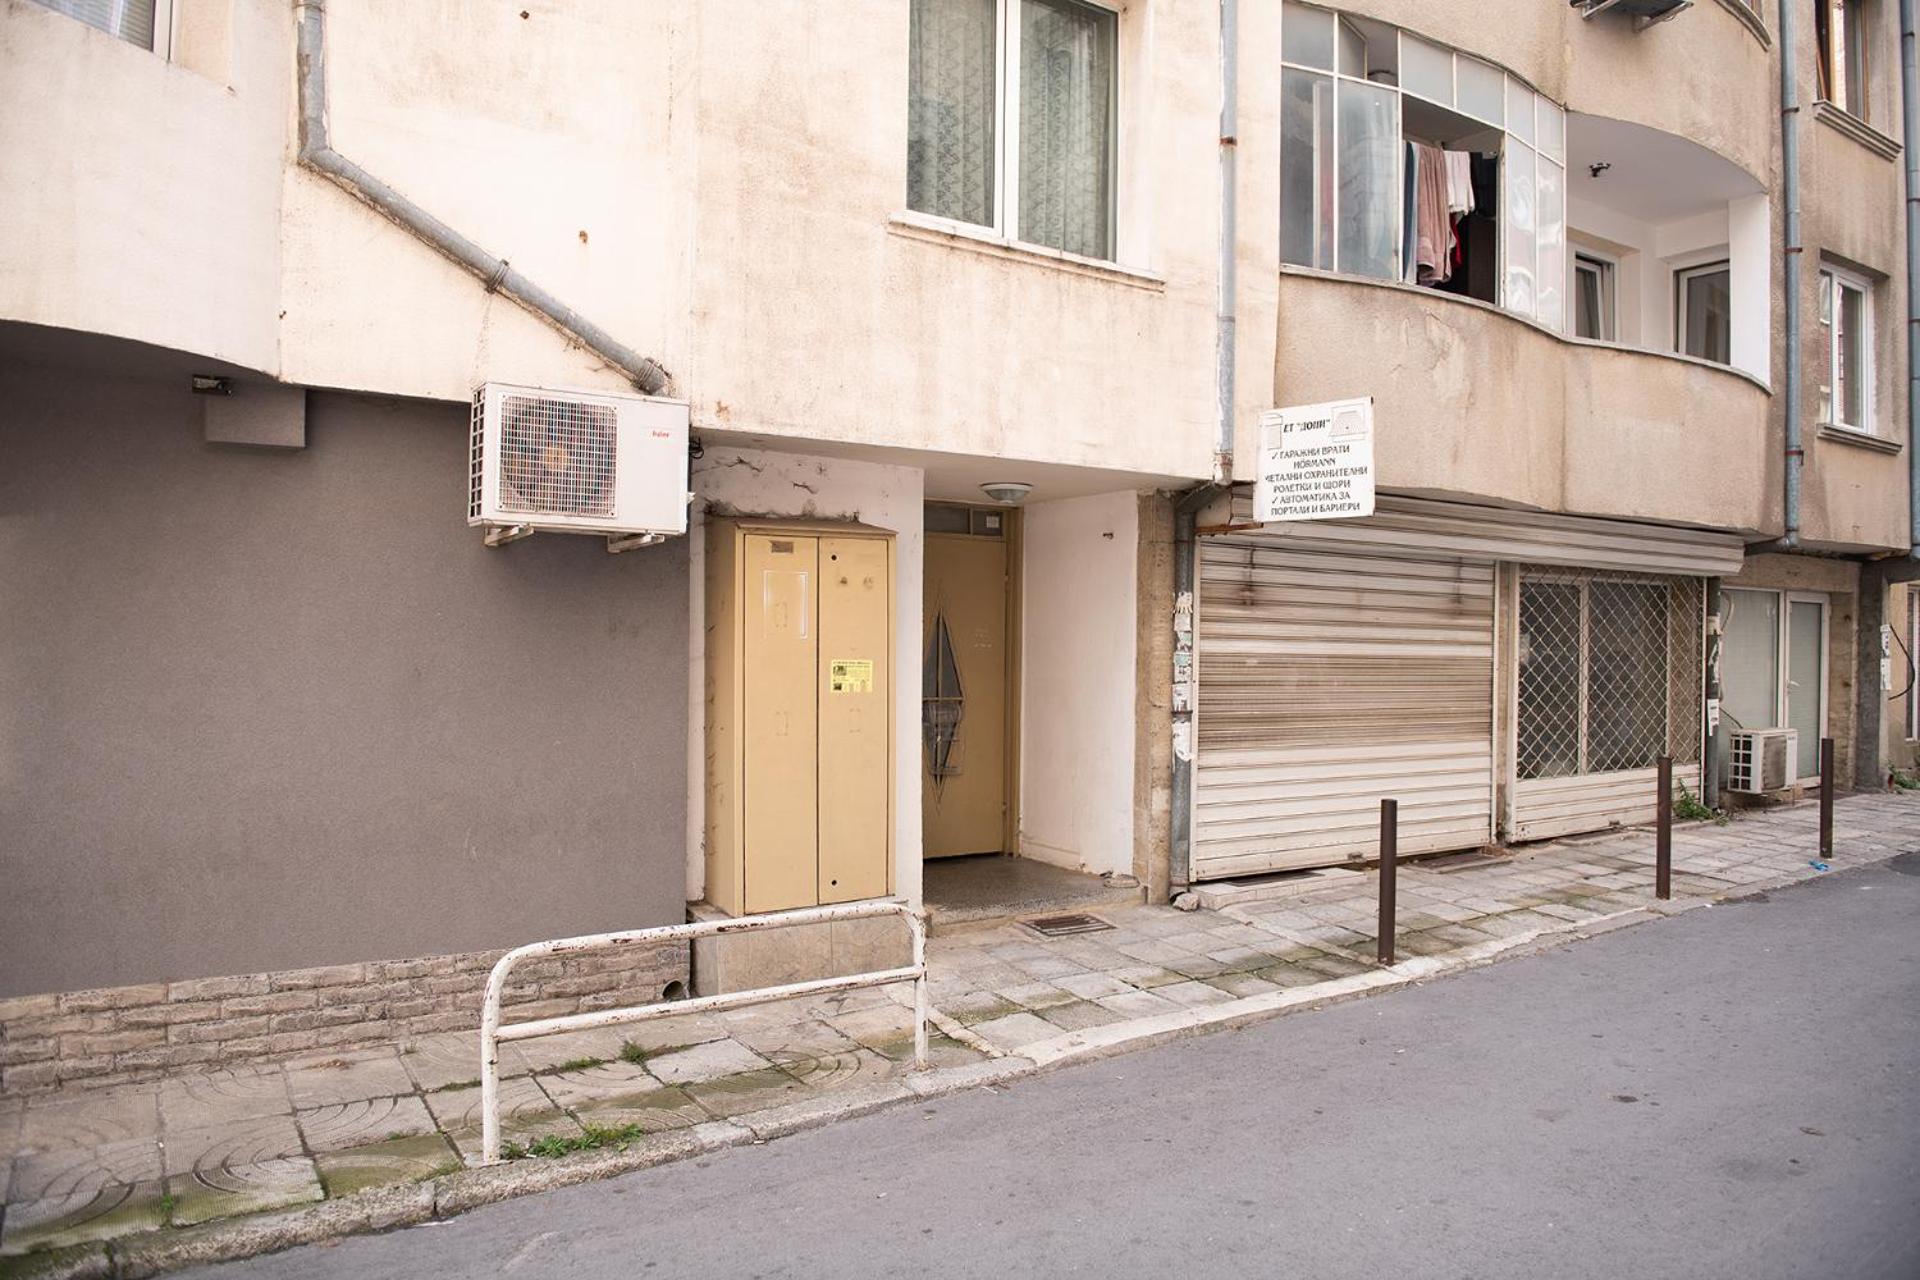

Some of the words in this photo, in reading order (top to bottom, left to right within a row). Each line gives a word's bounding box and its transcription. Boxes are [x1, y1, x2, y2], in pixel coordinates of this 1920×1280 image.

[1280, 448, 1320, 459] ГАРАЖНИ
[1322, 445, 1350, 455] ВРАТИ
[1304, 466, 1368, 479] ОХРАНИТЕЛНИ
[1273, 482, 1312, 493] РОЛЕТКИ
[1314, 482, 1321, 490] И
[1323, 480, 1351, 489] ШОРИ
[1280, 492, 1337, 504] АВТОМАТИКА
[1339, 491, 1351, 500] ЗА
[1271, 505, 1310, 516] ПОРТАЛИ
[1312, 505, 1318, 513] И
[1320, 502, 1360, 512] БАРИЕРИ
